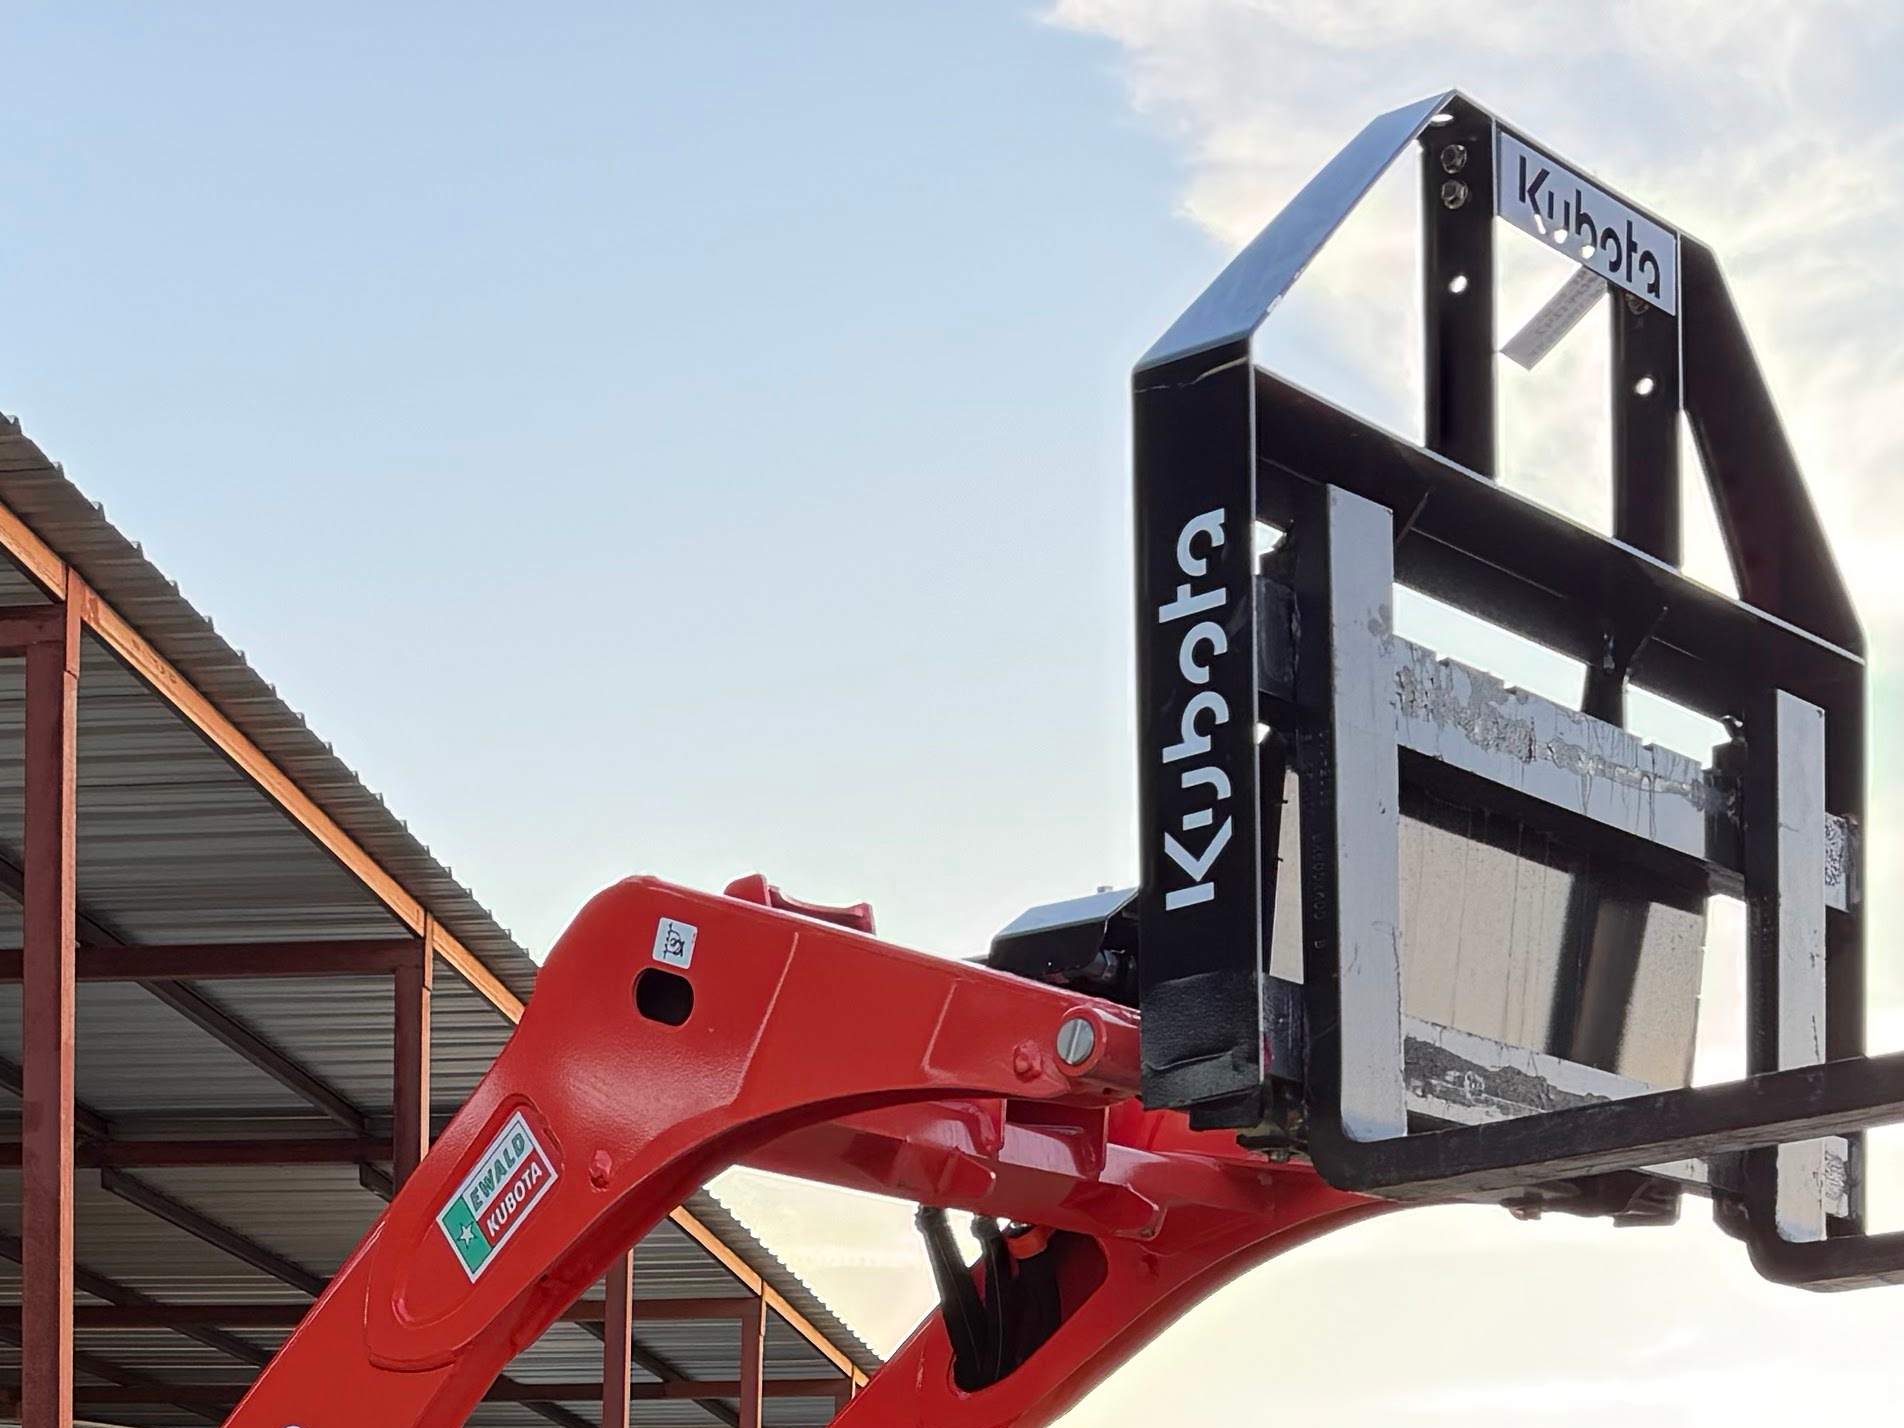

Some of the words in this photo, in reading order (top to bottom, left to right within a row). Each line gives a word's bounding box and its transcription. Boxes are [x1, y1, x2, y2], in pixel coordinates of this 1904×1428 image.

[1519, 155, 1660, 299] Kubota
[1159, 508, 1232, 911] Kubota
[470, 1133, 526, 1212] EWALD
[486, 1161, 543, 1237] KUBOTA
